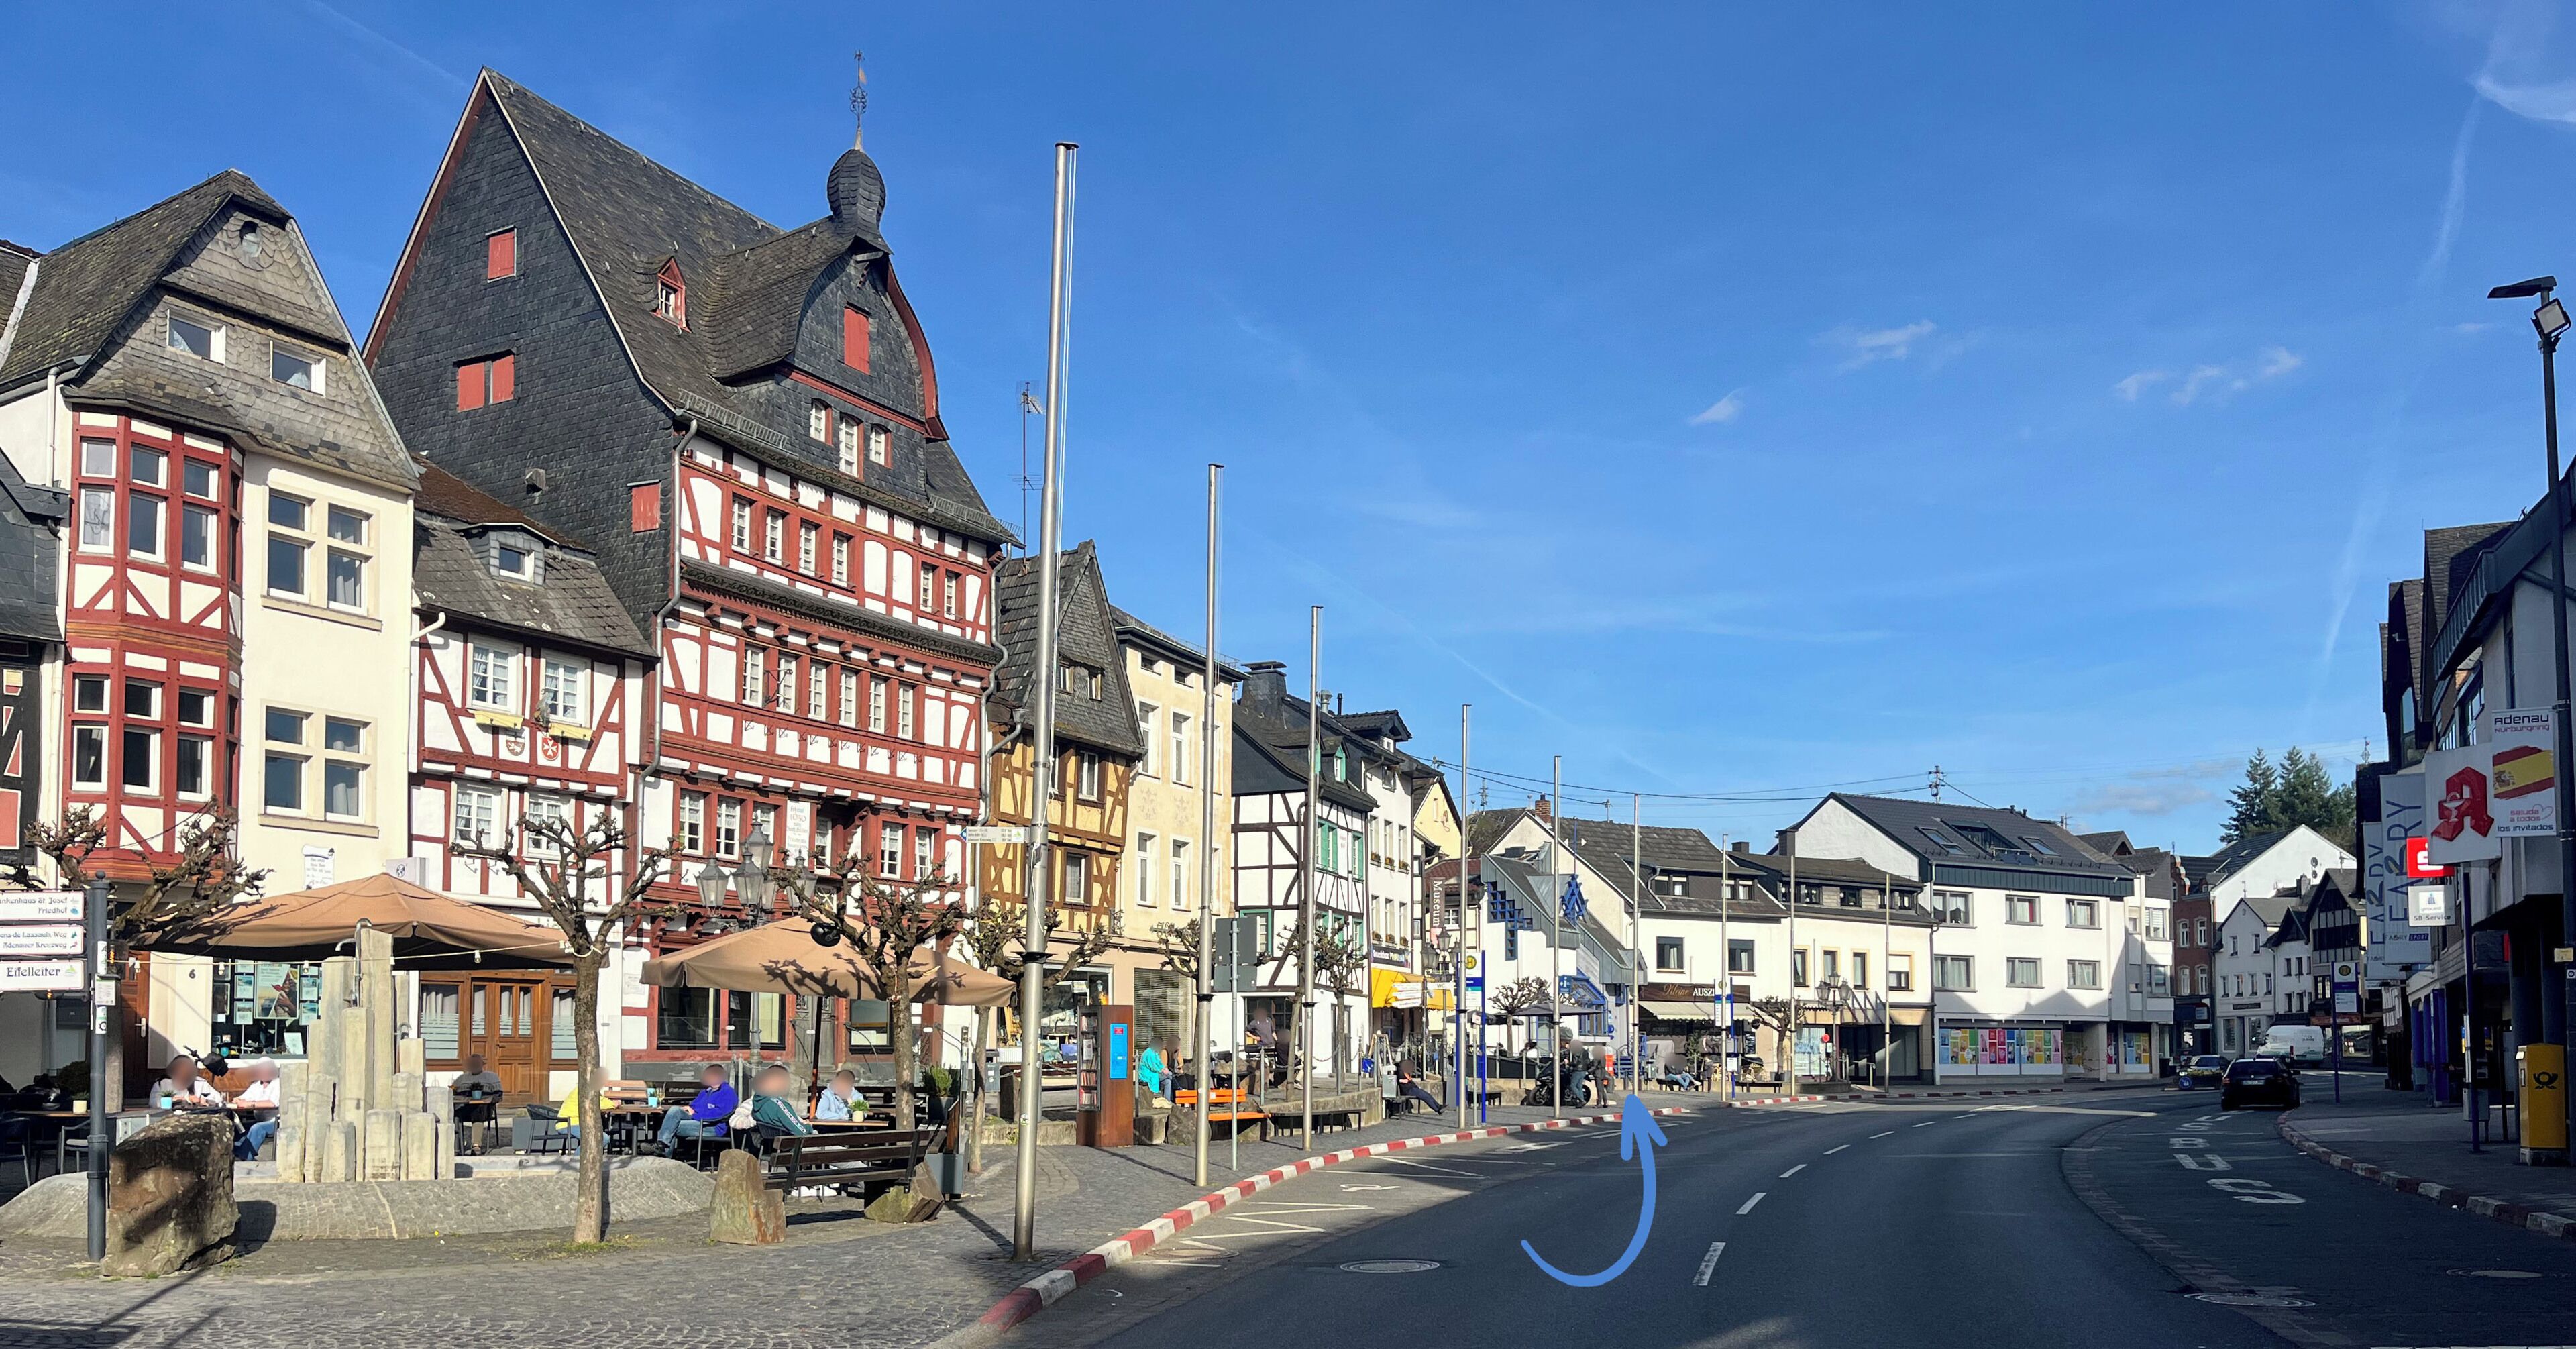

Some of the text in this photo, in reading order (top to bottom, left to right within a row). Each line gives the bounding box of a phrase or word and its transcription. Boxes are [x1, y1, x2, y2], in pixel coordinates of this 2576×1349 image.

[2494, 714, 2549, 726] Adenau
[2513, 824, 2554, 832] invitados
[6, 967, 61, 977] Eifelleiter
[189, 969, 196, 979] 6
[1663, 984, 1715, 997] Kleine AUSZ
